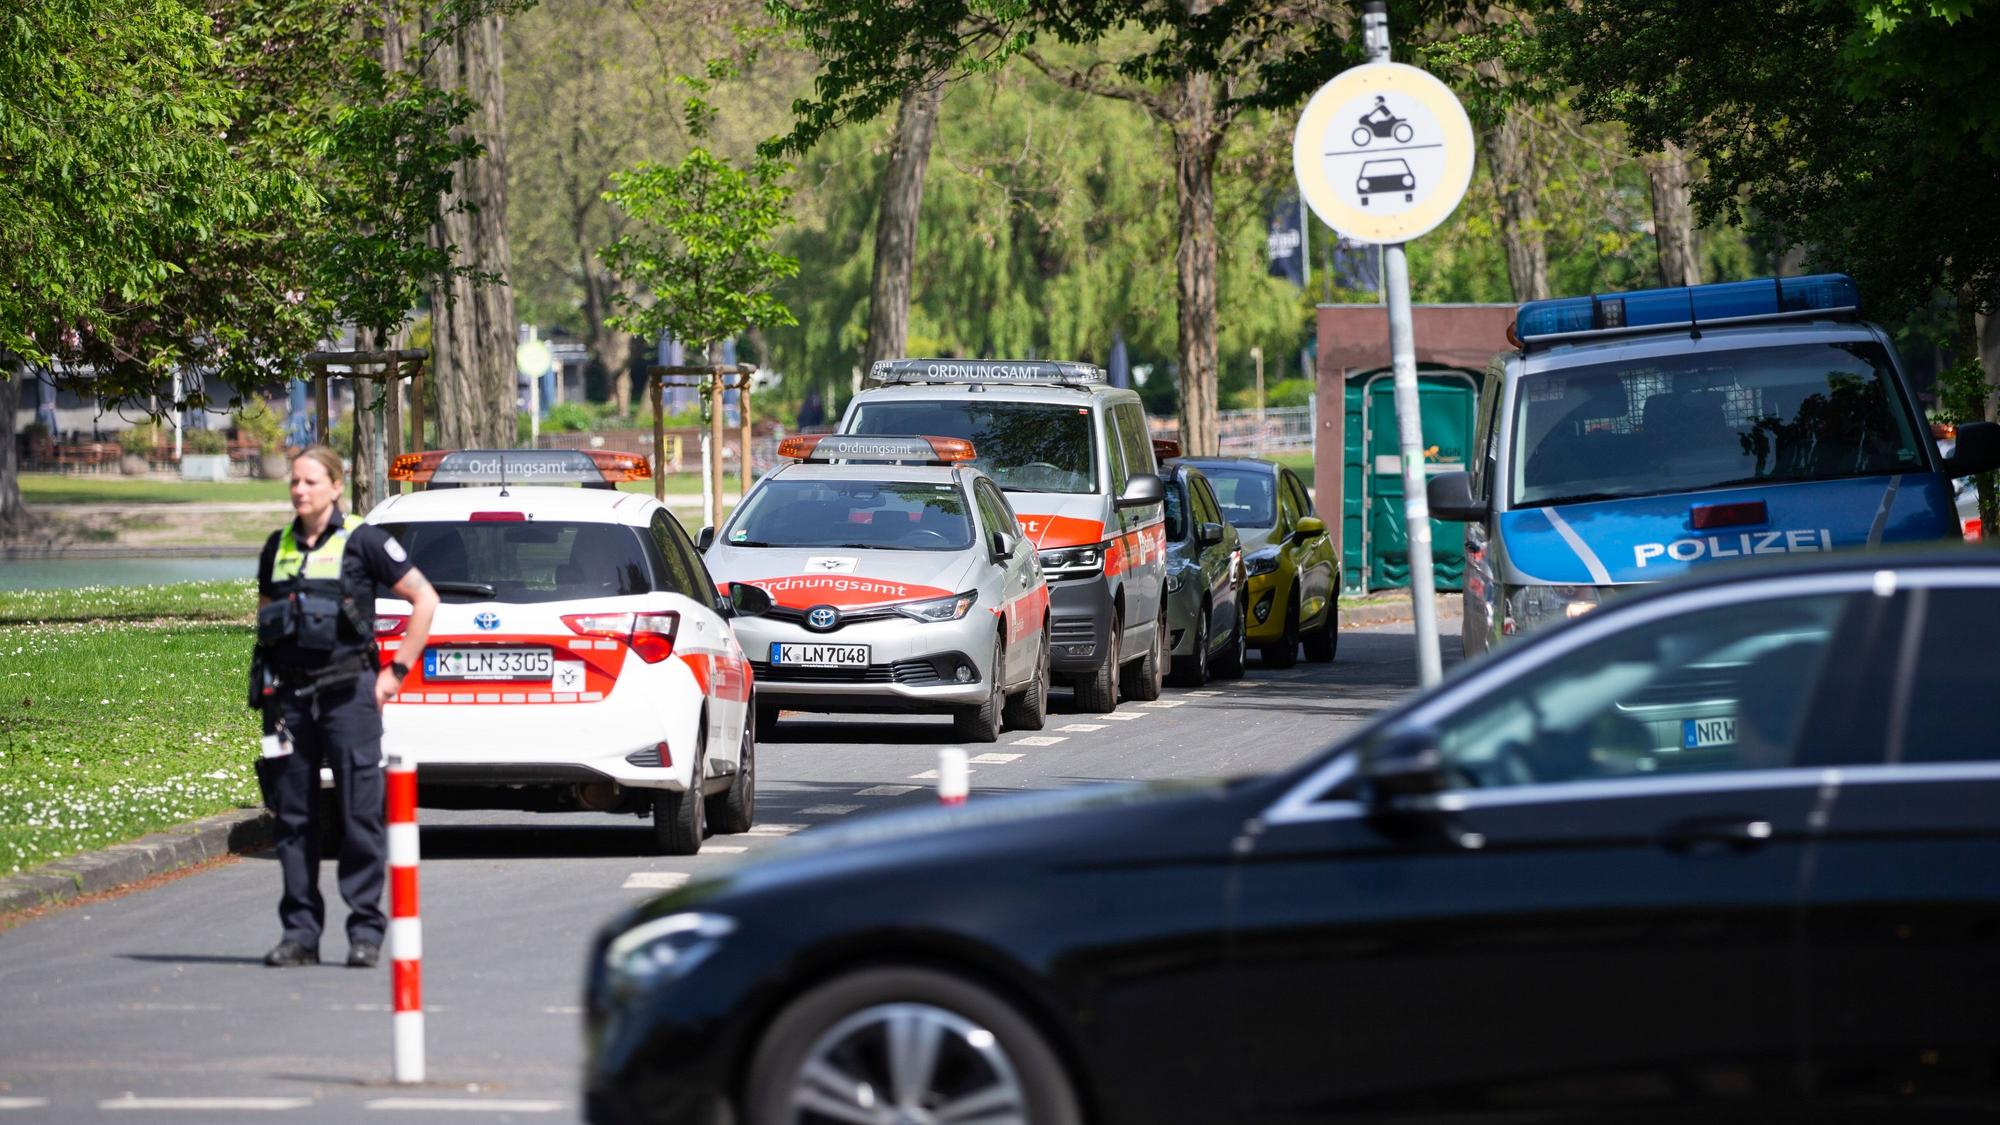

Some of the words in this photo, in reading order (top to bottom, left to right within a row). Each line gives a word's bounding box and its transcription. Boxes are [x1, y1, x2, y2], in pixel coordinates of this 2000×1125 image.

[928, 364, 1040, 379] ORDNUNGSAMT
[839, 442, 912, 455] Ordnungsamt
[469, 460, 567, 477] Ordnungsamt
[1634, 529, 1831, 568] POLIZEI
[439, 653, 451, 672] K
[498, 653, 549, 671] 3305
[782, 647, 792, 662] K
[827, 648, 866, 663] 7048
[1697, 720, 1735, 742] NRW
